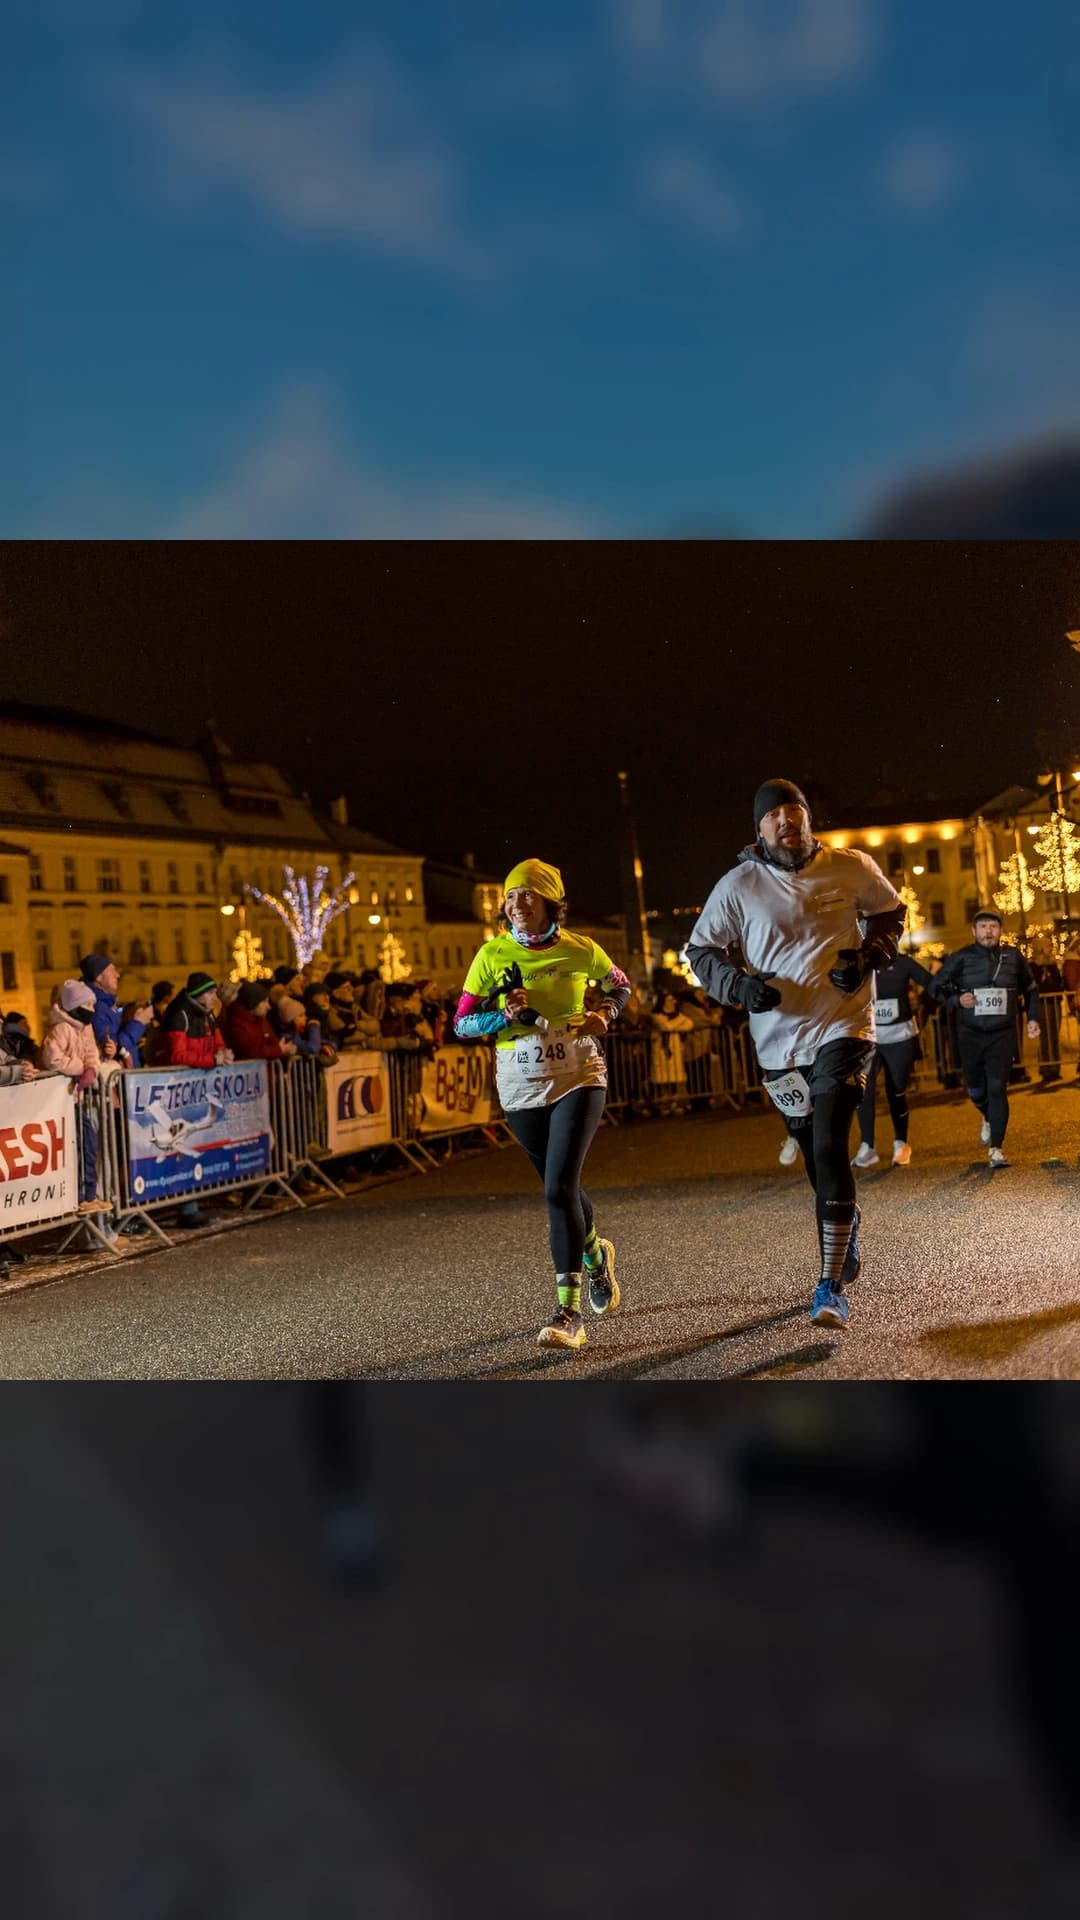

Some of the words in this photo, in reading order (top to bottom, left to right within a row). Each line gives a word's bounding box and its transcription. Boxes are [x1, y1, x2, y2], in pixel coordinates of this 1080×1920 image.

[986, 997, 1003, 1008] 509
[876, 1008, 893, 1018] 486
[534, 1042, 566, 1064] 248
[214, 1069, 261, 1099] ŠKOLA
[776, 1089, 804, 1106] 899
[0, 1116, 65, 1182] ESH
